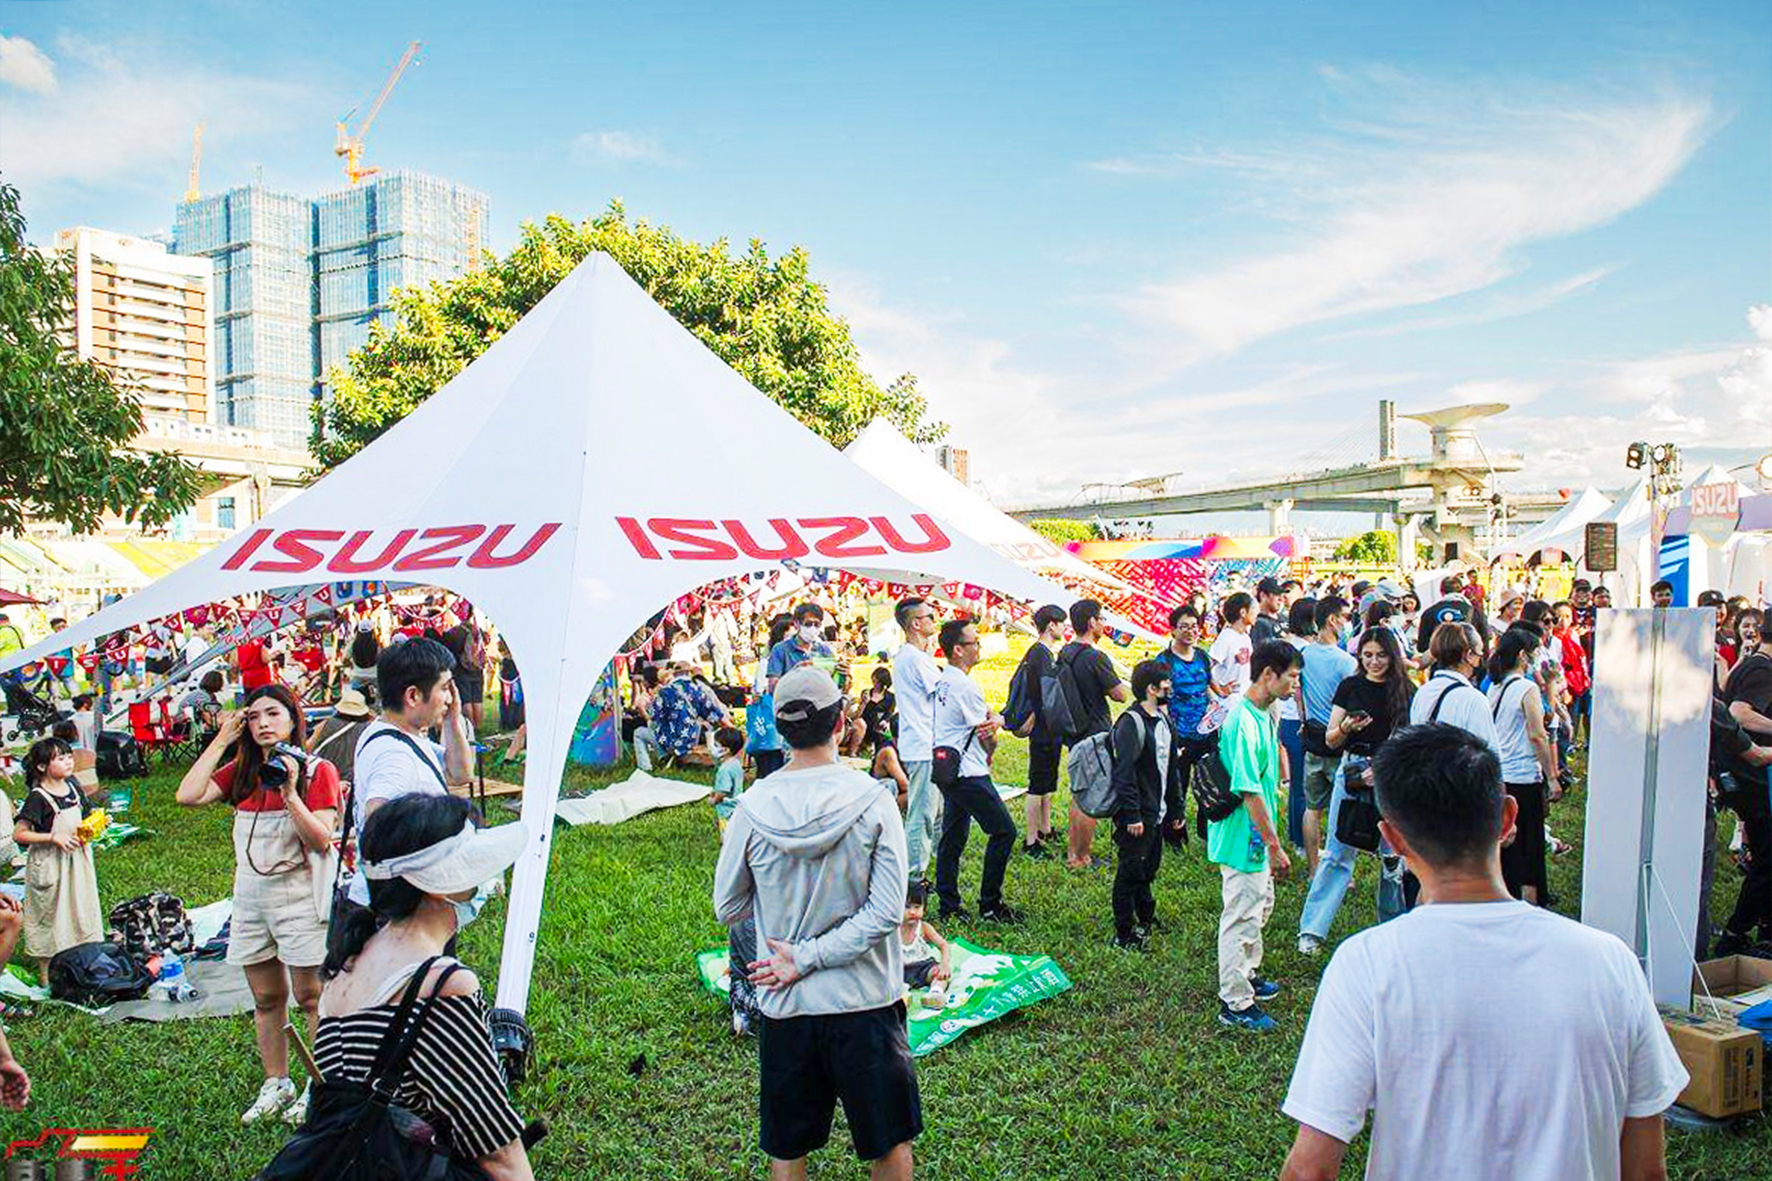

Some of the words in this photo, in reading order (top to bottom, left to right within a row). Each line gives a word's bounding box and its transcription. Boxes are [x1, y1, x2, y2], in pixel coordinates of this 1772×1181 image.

[1691, 481, 1738, 516] ISUZU
[220, 523, 563, 573] ISUZU
[615, 513, 951, 560] ISUZU
